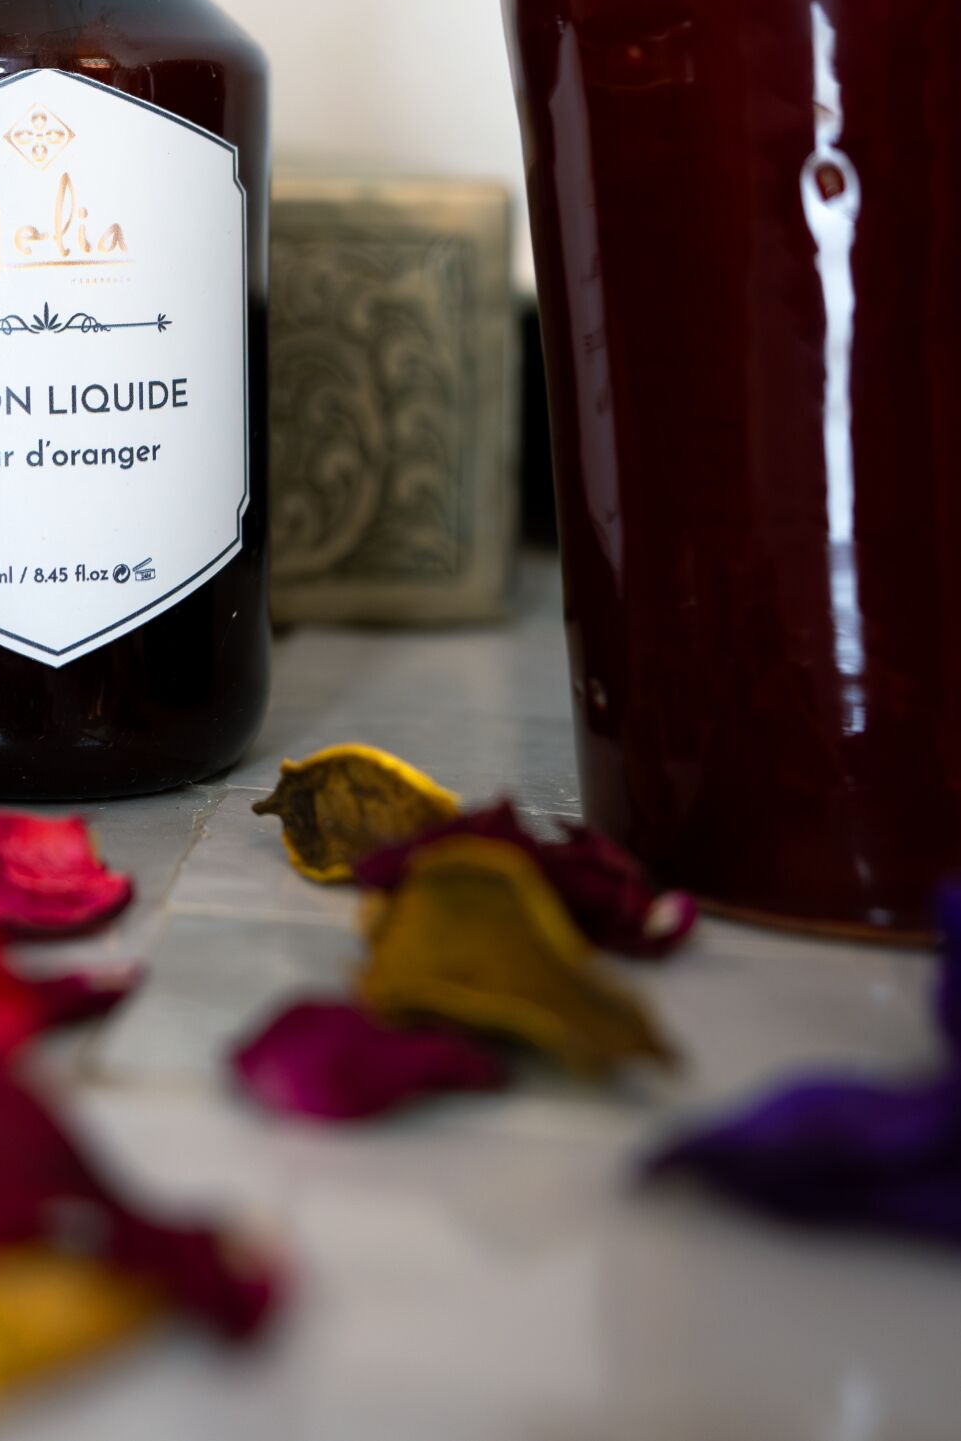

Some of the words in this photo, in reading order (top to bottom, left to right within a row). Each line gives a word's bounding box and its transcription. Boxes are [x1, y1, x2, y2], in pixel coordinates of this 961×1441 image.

[48, 377, 189, 415] LIQUIDE
[25, 438, 162, 471] d'oranger
[19, 565, 28, 585] /
[33, 566, 69, 584] 8.45
